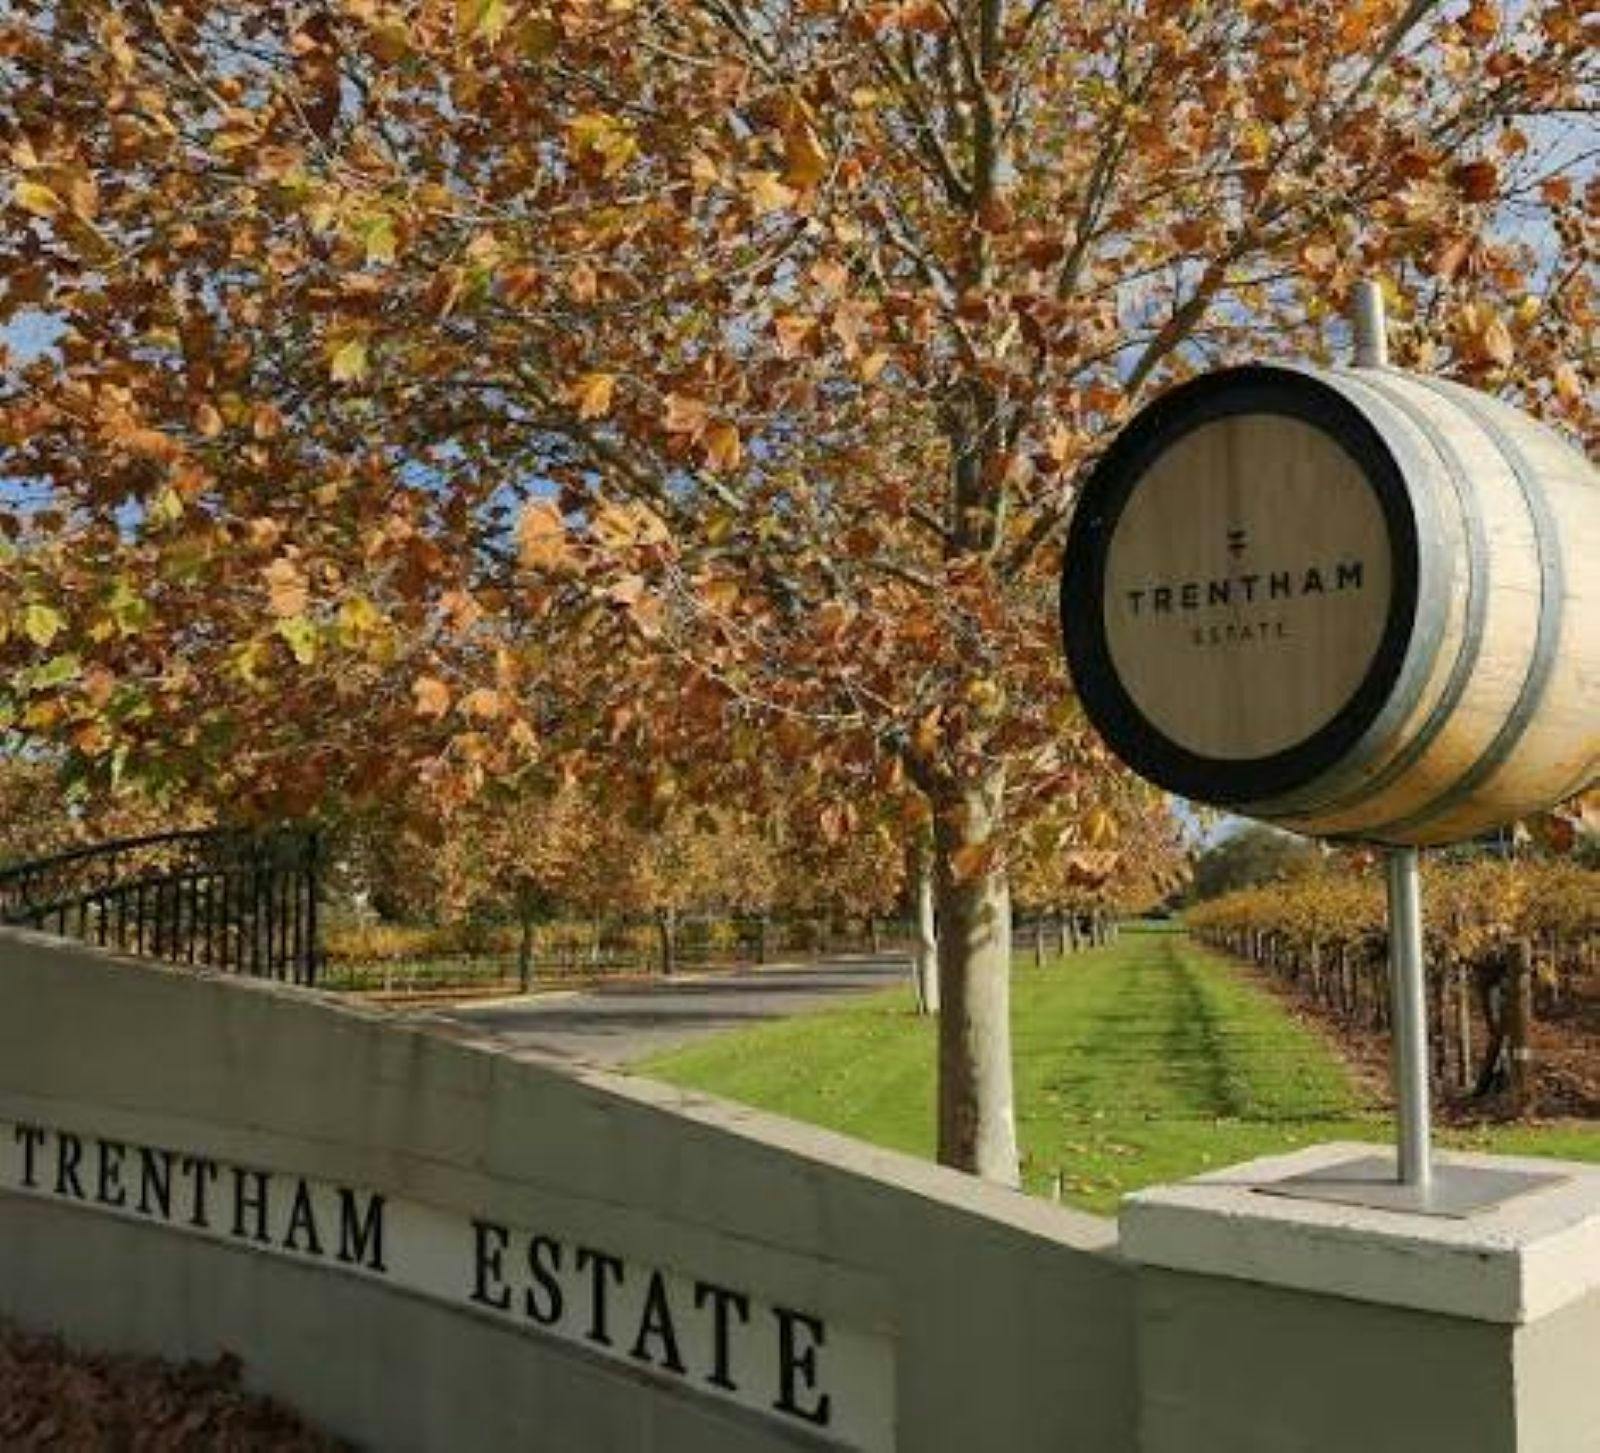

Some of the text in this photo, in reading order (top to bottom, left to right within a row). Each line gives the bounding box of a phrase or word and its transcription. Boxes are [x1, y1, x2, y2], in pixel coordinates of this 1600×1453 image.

[1127, 561, 1364, 617] TRENTHAM
[14, 1122, 831, 1426] TRENTHAM ESTATE
